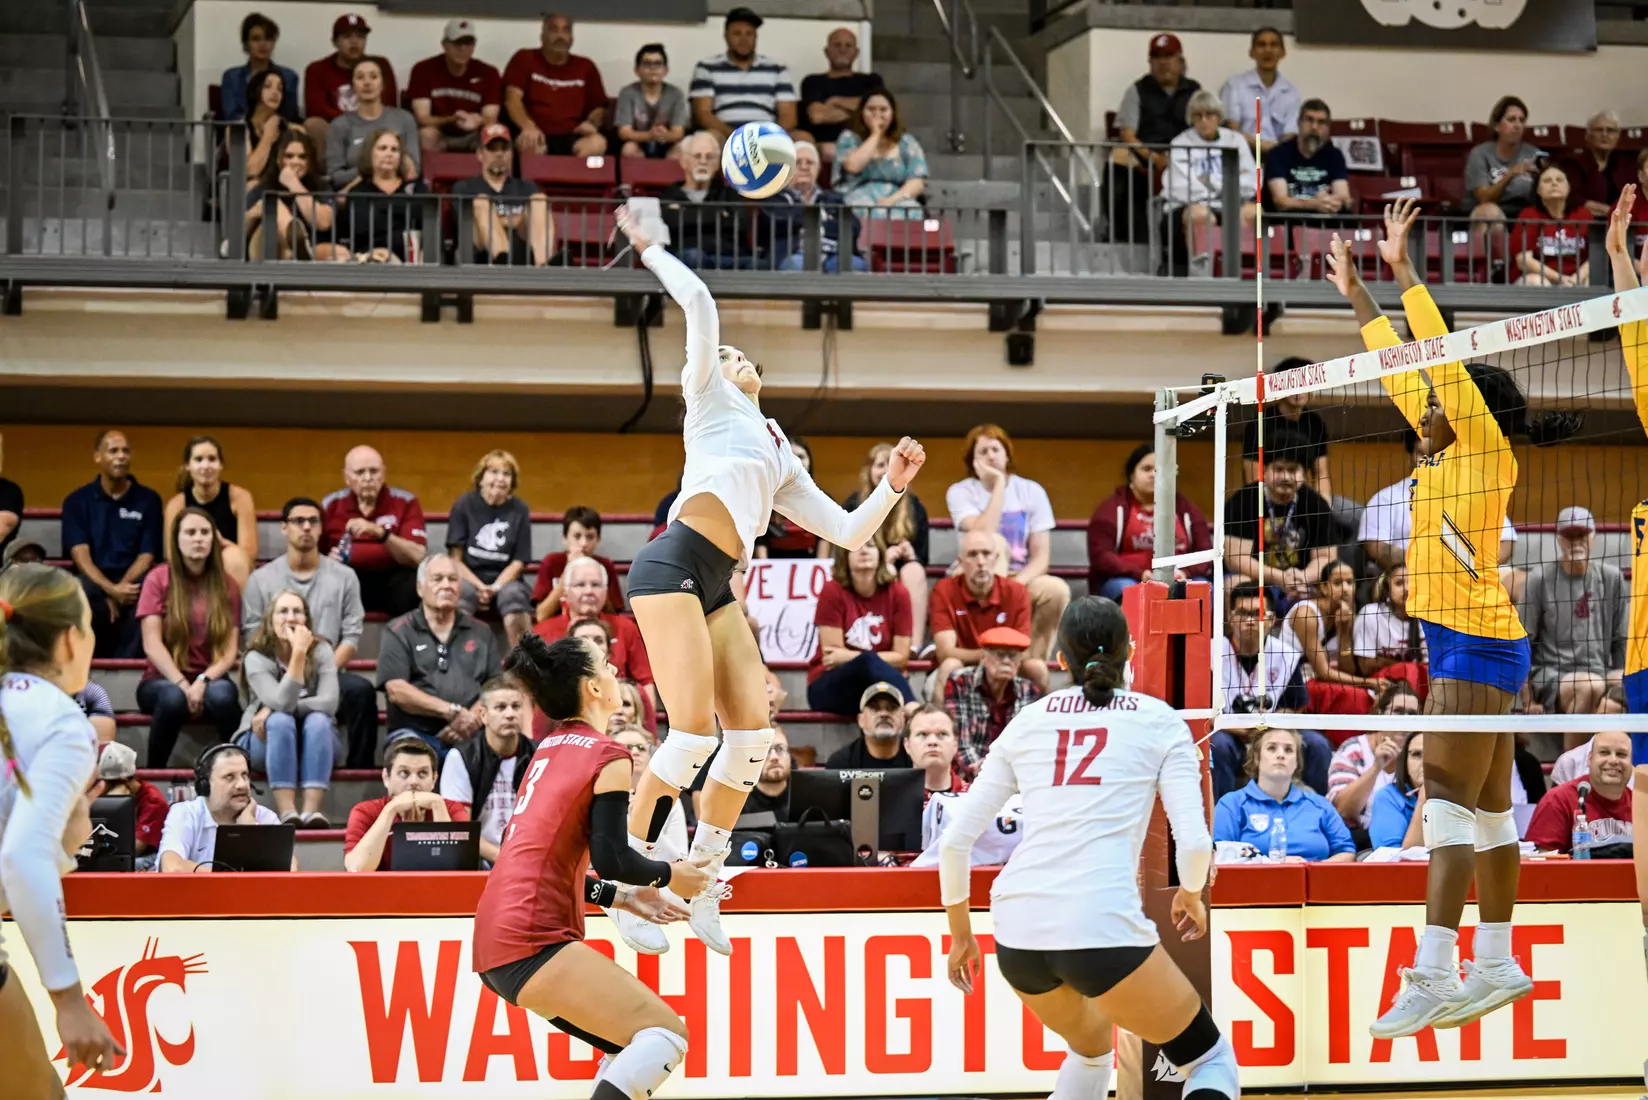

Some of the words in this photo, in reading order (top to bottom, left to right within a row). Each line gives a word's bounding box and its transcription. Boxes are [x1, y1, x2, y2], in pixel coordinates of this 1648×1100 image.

[1504, 311, 1557, 343] WASHINGTON
[1557, 304, 1583, 331] STATE
[1378, 340, 1424, 371] WASHINGTON
[1424, 336, 1446, 361] STATE
[1268, 369, 1307, 393] WASHINGTON
[1308, 363, 1327, 386] STATE
[744, 564, 774, 600] E
[1046, 695, 1139, 713] COURS
[562, 733, 599, 749] STATE
[1051, 727, 1109, 787] 12
[513, 757, 550, 816] 3
[346, 933, 1119, 1084] WAHINGT
